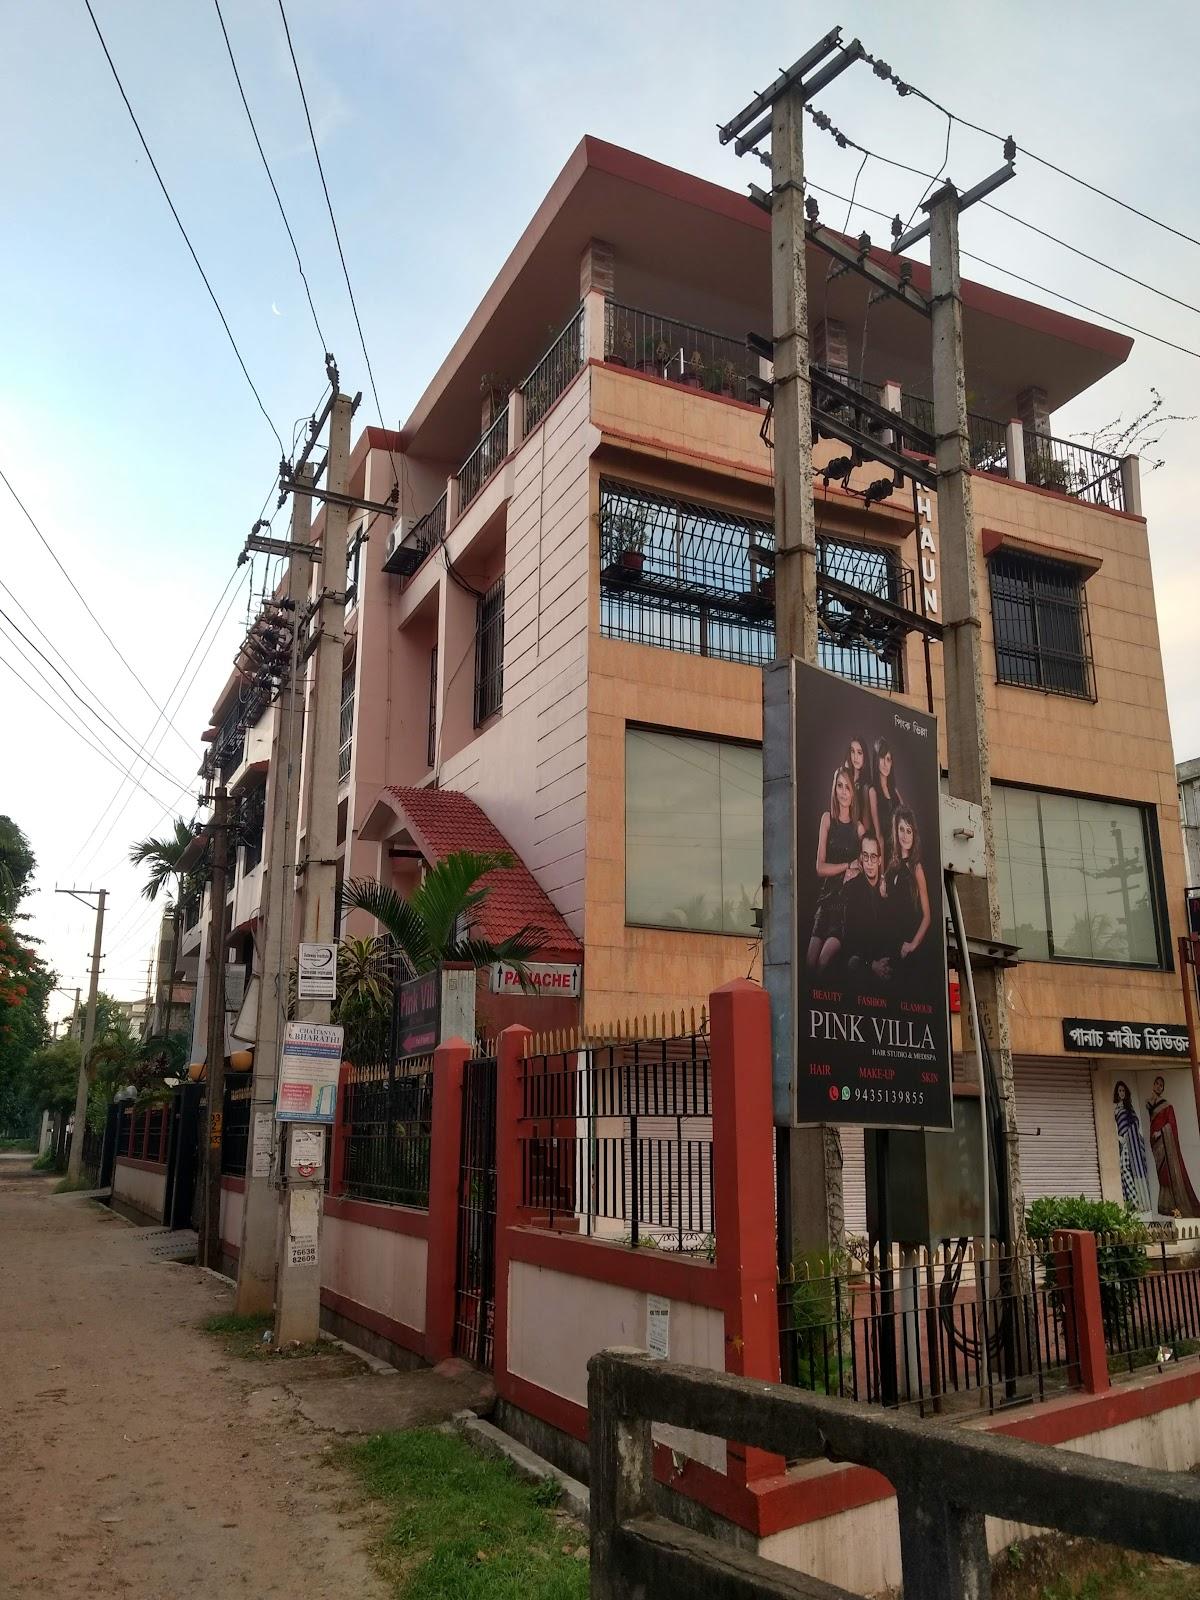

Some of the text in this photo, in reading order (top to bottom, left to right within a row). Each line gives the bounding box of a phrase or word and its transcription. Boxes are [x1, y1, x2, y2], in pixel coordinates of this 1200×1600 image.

[812, 989, 933, 1014] BEAUTY FASHION GLAMOUR
[295, 1033, 340, 1044] BHARATHI
[809, 1009, 866, 1043] PINK
[871, 1017, 936, 1050] VILLA
[1143, 1028, 1190, 1052] ডিভিজ
[872, 1048, 886, 1056] HAIR
[887, 1050, 908, 1058] STUDIO
[913, 1053, 937, 1061] MEDISPA
[809, 1063, 939, 1083] HAIR MAKE-UP SKIN
[855, 1088, 924, 1105] 9435139855
